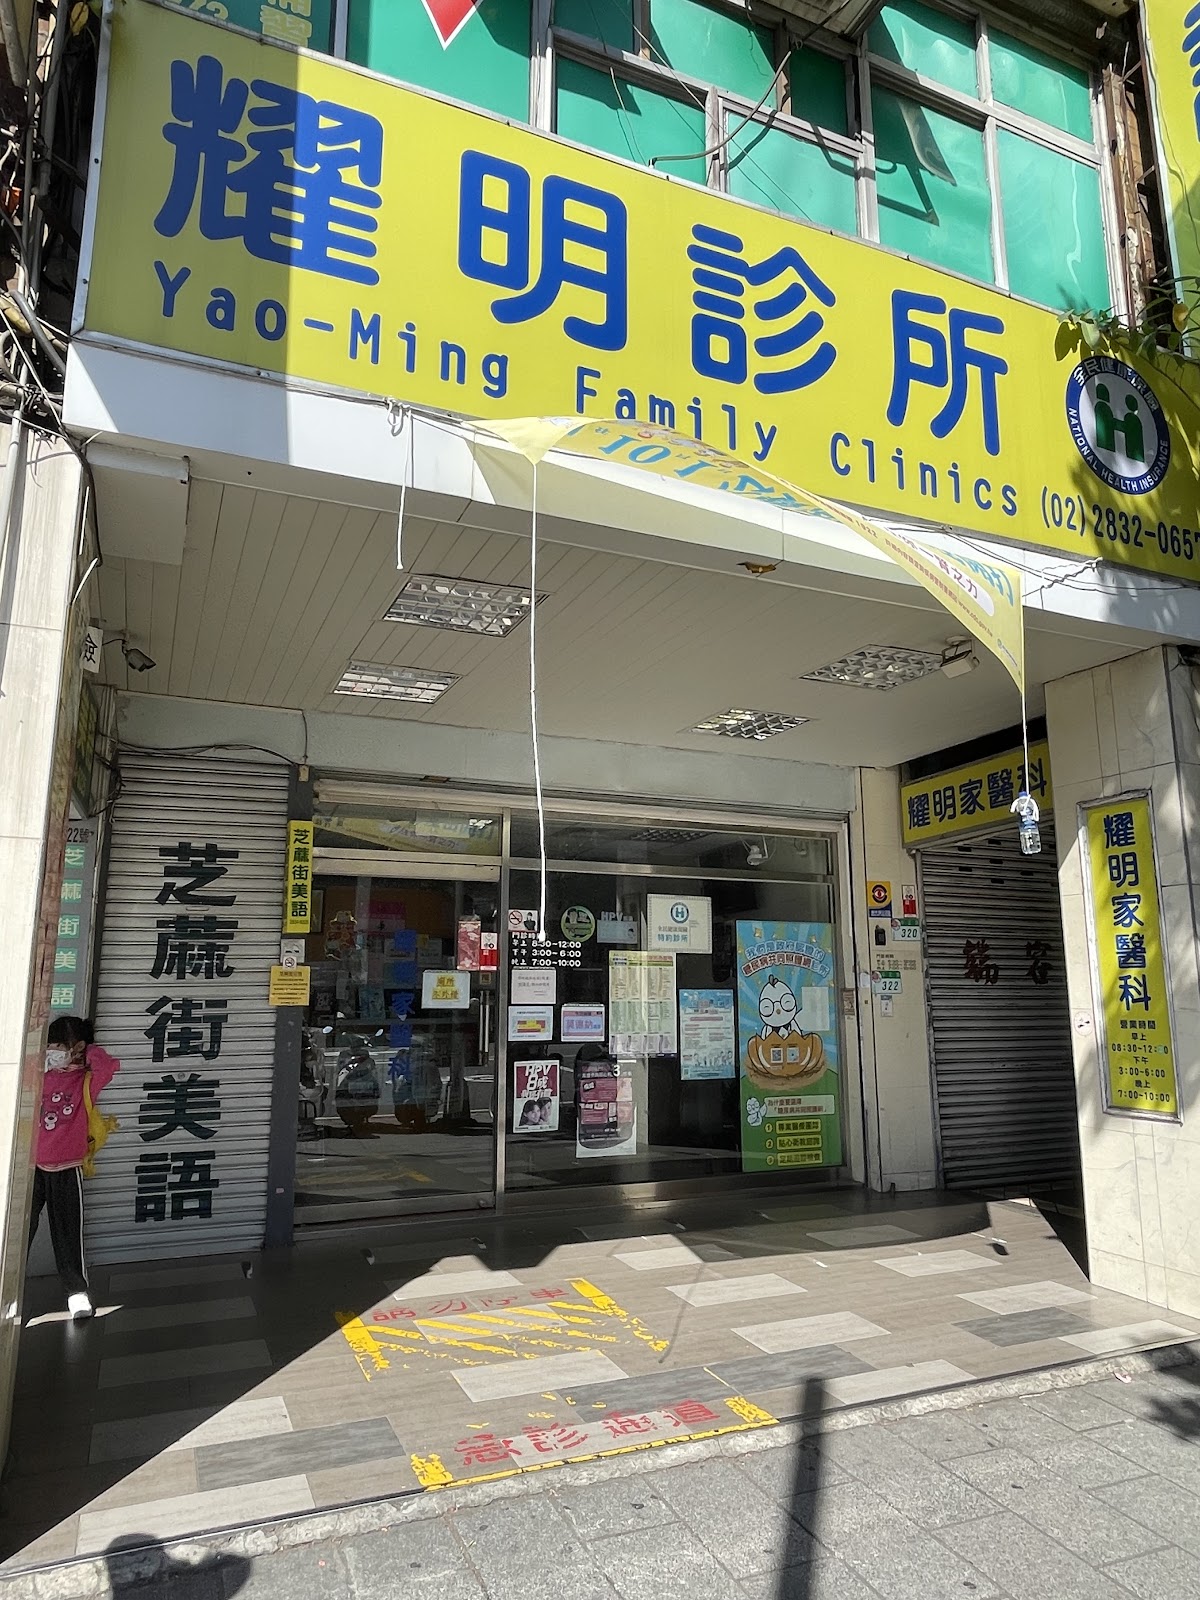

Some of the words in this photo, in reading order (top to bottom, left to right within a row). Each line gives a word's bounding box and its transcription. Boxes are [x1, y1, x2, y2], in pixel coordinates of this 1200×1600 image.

[154, 55, 1008, 456] 耀明診所
[154, 260, 509, 399] Yao-Ming
[576, 366, 777, 462] Family
[830, 432, 1018, 518] Clinics
[1068, 406, 1099, 472] NATIONAL
[1100, 467, 1139, 493] HEALTH
[1139, 438, 1169, 492] INSURANCE
[1041, 485, 1087, 538] (02)
[907, 757, 1047, 830] 耀明家醫科
[901, 928, 918, 938] 320
[1103, 811, 1151, 1012] 耀明家醫科
[512, 948, 528, 956] 下午
[881, 980, 899, 991] 322
[1131, 1032, 1147, 1041] 早上
[1133, 1056, 1149, 1065] 下午
